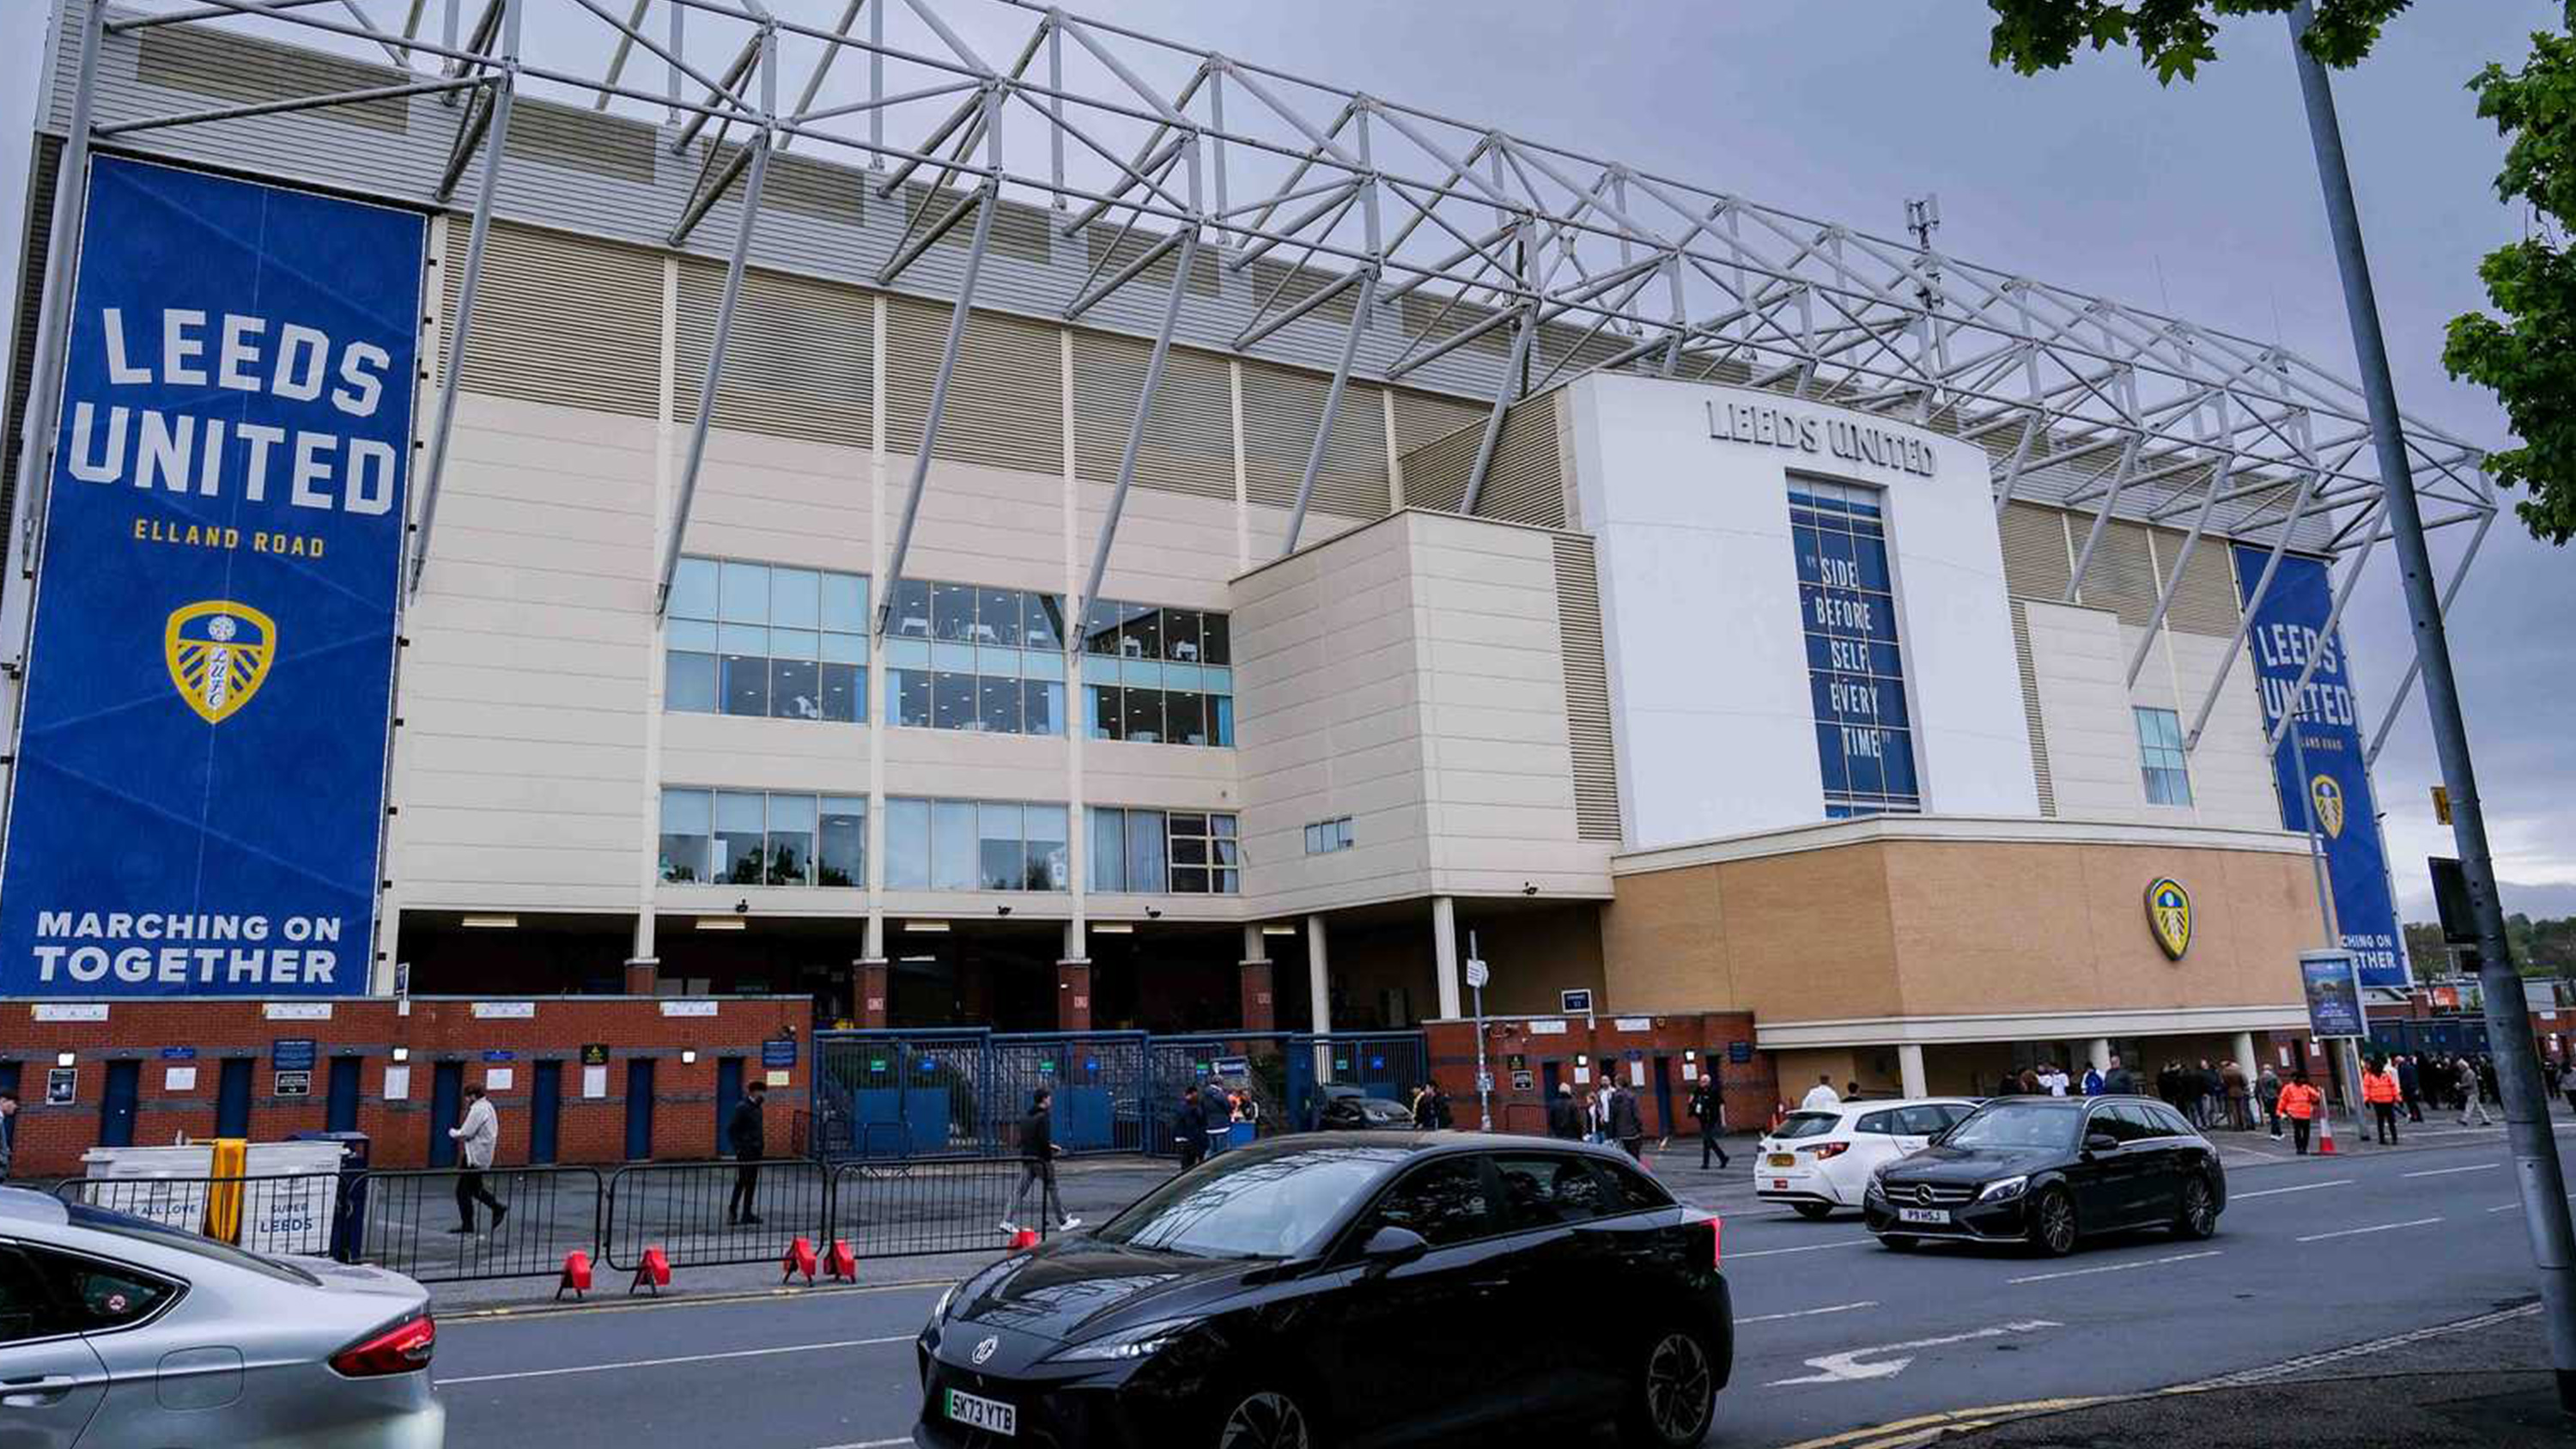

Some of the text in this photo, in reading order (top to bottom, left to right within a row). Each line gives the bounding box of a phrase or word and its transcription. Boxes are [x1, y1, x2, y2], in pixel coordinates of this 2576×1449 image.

[103, 307, 391, 417] LEEDS
[1706, 400, 1936, 477] LEEDS UNITED
[68, 402, 397, 515] UNITED
[135, 518, 325, 558] ELLAND ROAD
[1815, 596, 1874, 630] BEFORE
[2257, 624, 2337, 674] LEEDS
[1831, 683, 1879, 715] EVERY
[2261, 677, 2354, 726] UNITED
[36, 910, 342, 941] MARCHING ON
[2376, 934, 2392, 947] ON
[33, 946, 337, 983] TOGETHER
[259, 1217, 313, 1233] LEEDS
[985, 1402, 1013, 1431] YTB
